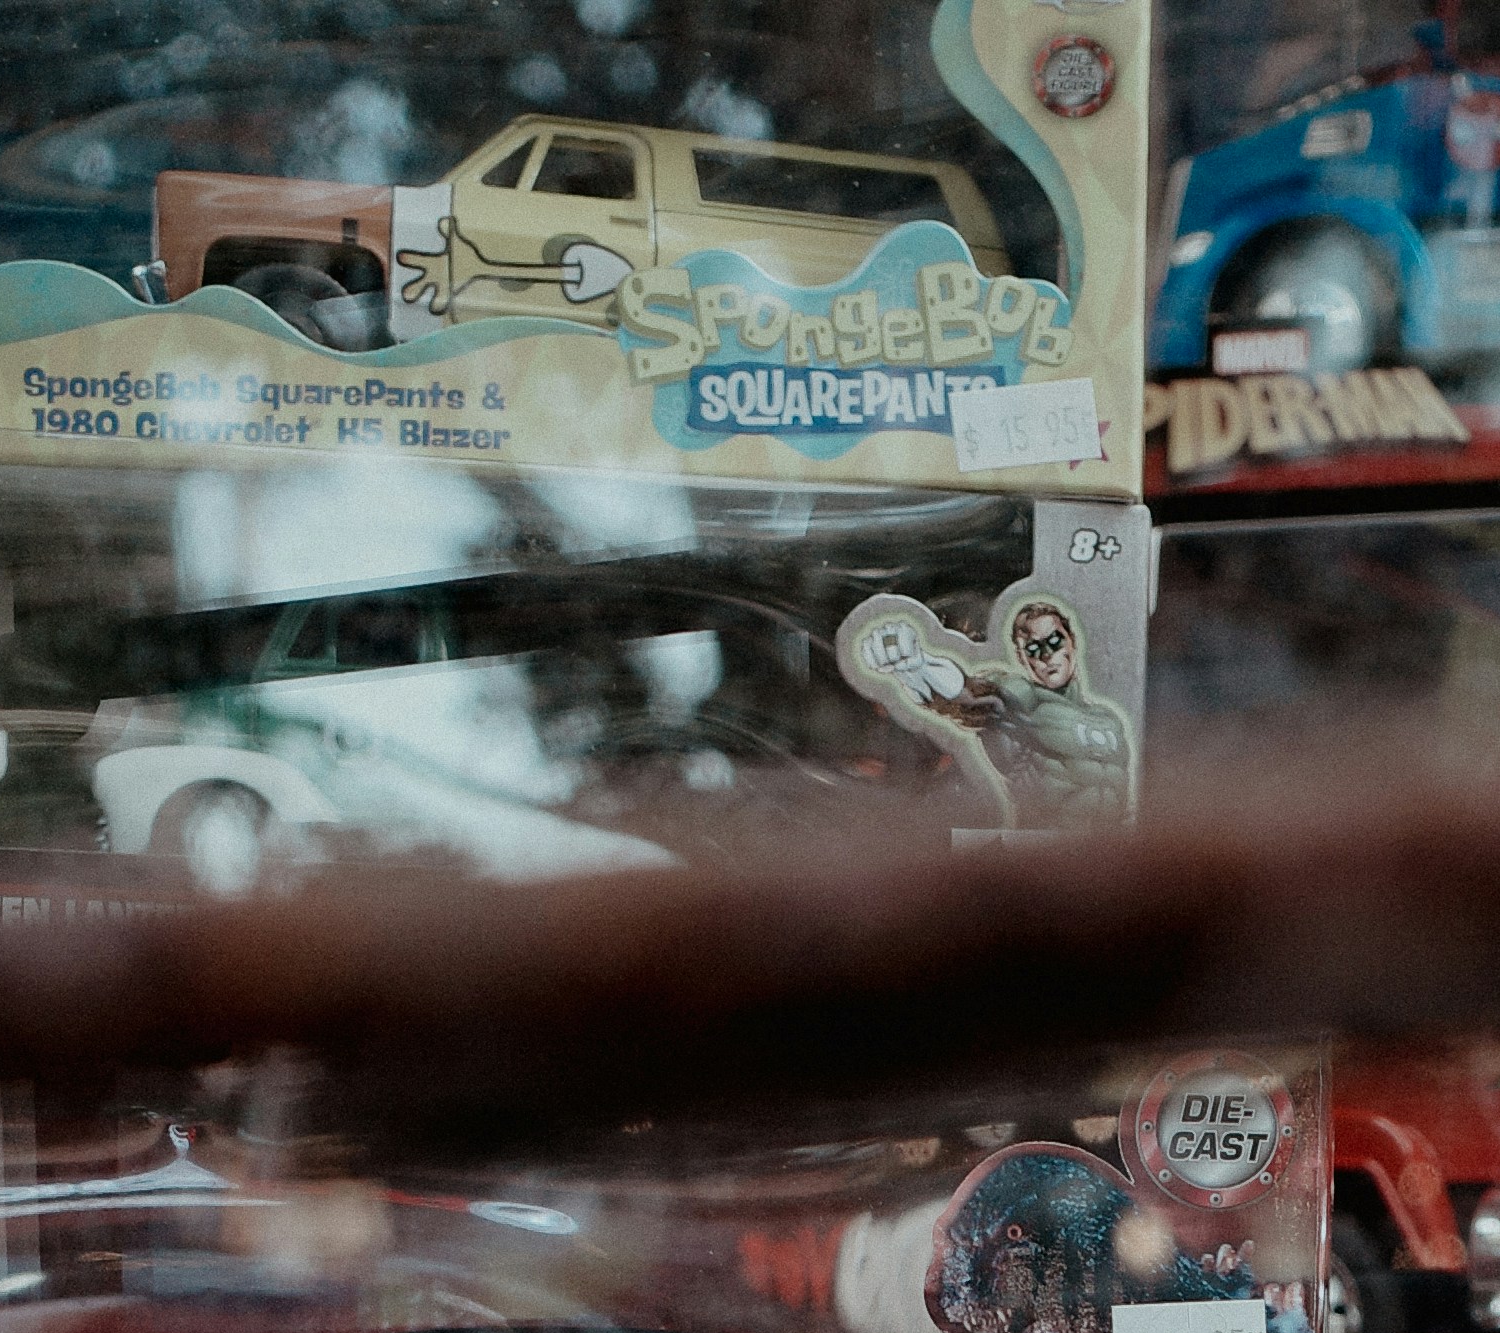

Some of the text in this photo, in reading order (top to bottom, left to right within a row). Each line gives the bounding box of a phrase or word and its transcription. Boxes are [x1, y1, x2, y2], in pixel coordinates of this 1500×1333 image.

[617, 262, 1077, 384] SpongeBob
[482, 391, 505, 412] &
[32, 408, 119, 438] 1980
[400, 420, 510, 451] Blazer
[1068, 528, 1122, 563] 8+
[1180, 1093, 1254, 1127] DIE-
[1168, 1131, 1268, 1164] CAST
